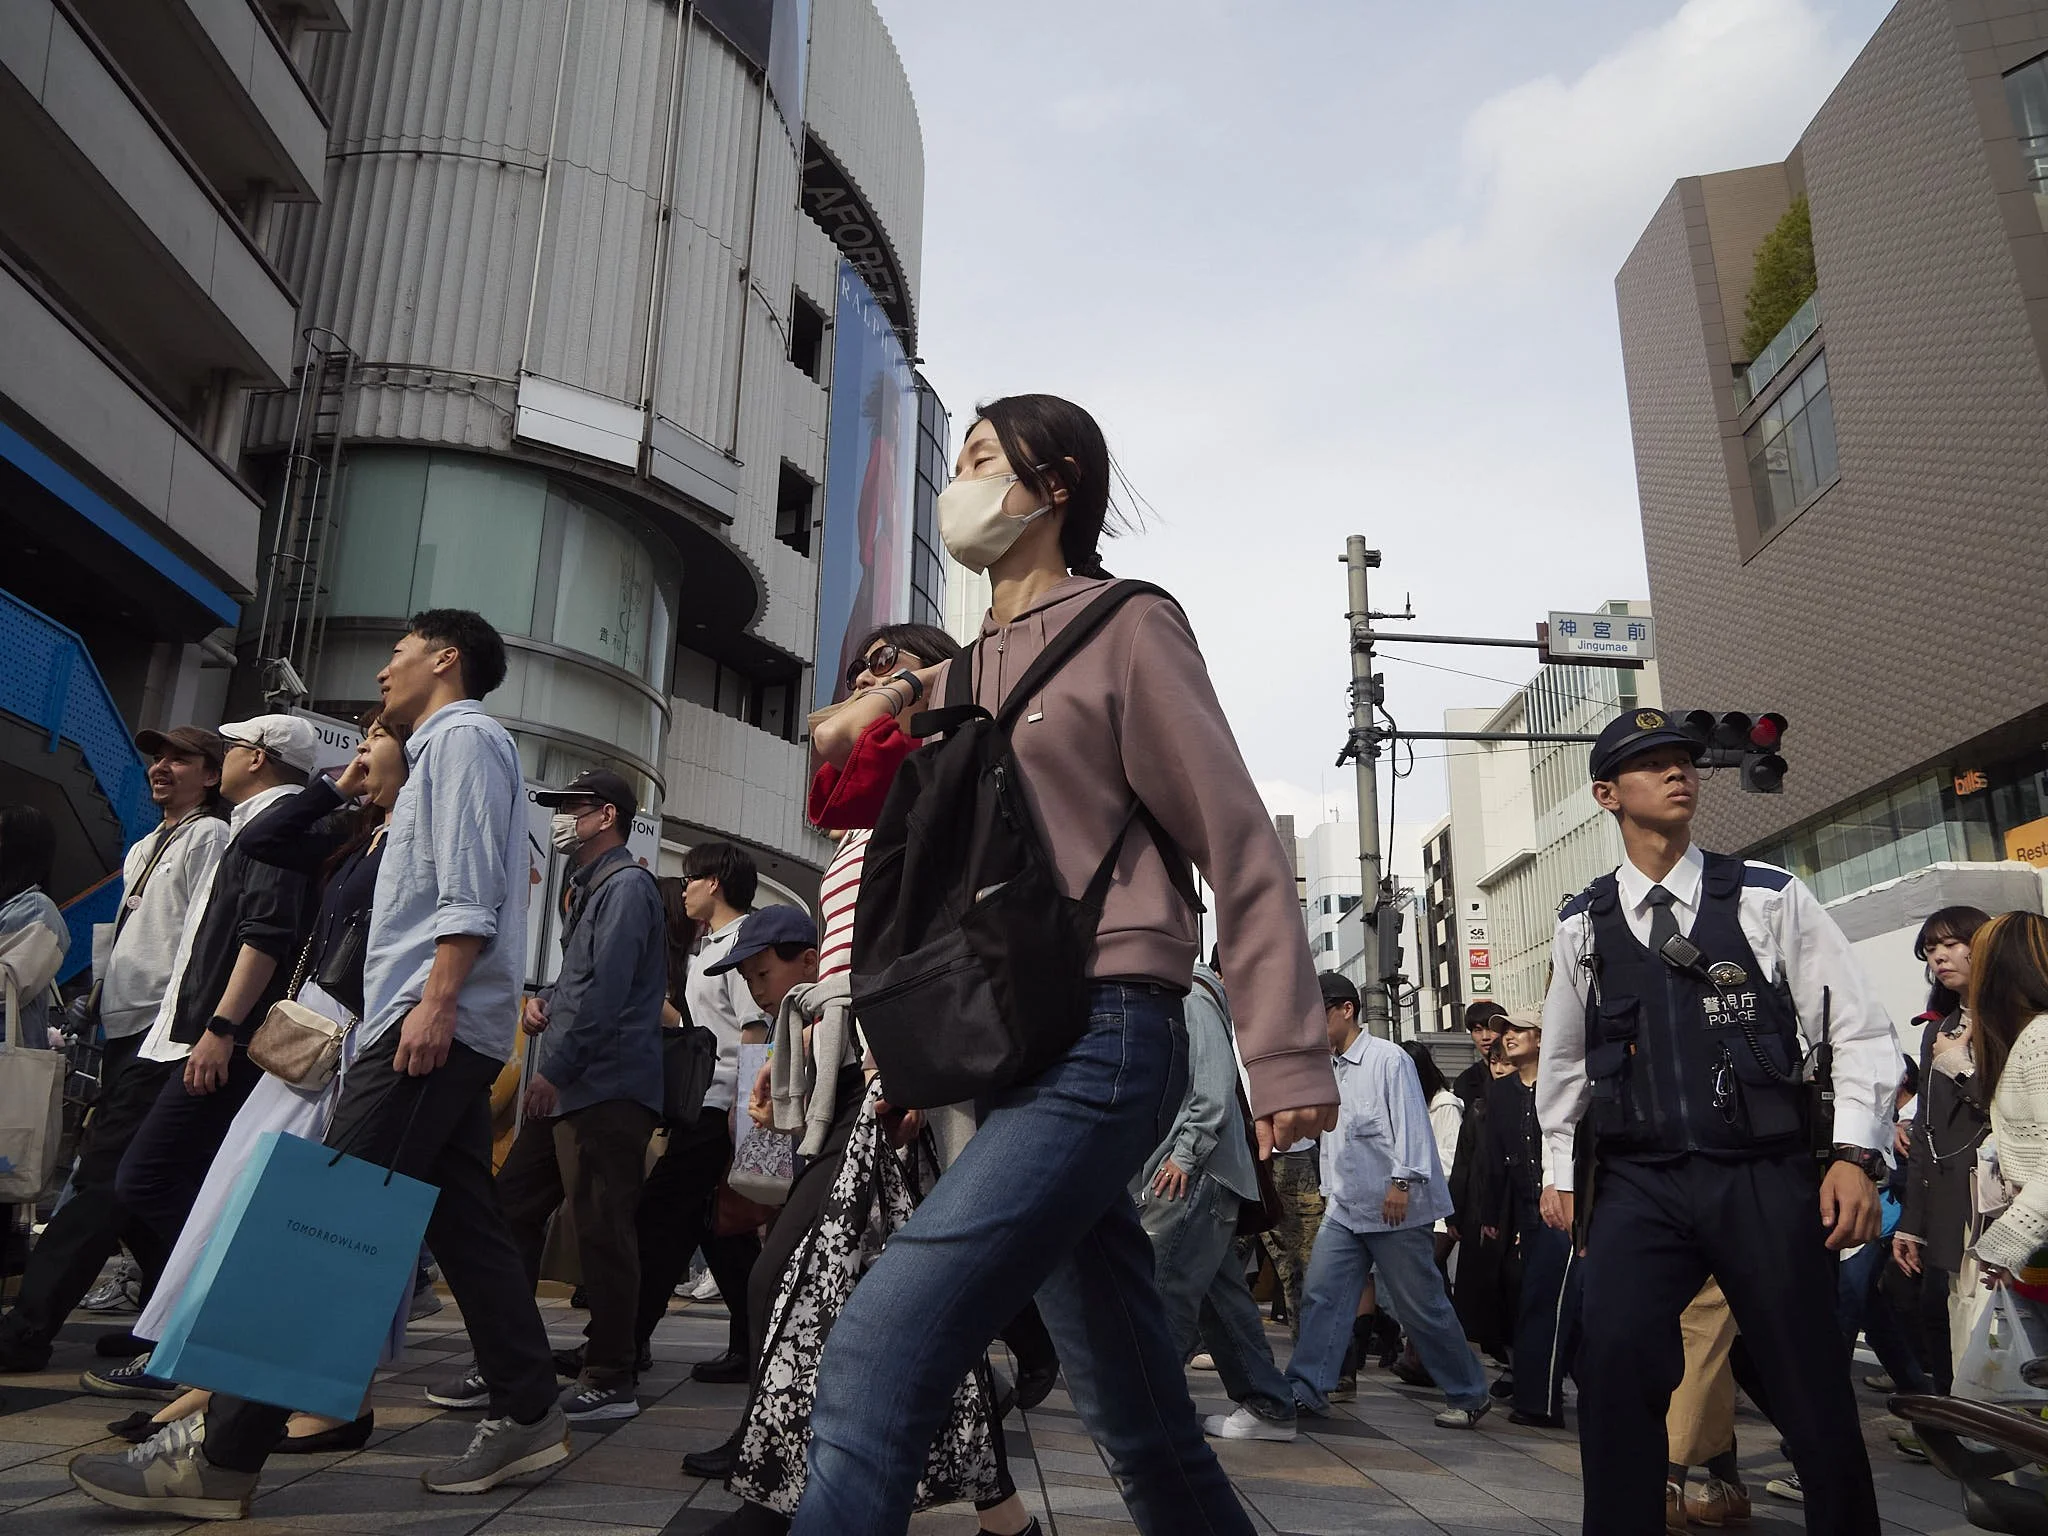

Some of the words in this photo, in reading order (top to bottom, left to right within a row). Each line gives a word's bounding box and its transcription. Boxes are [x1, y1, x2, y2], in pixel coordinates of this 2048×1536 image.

[841, 276, 888, 353] RALPH
[1558, 618, 1646, 641] 神宮前
[1577, 639, 1629, 653] Jingumae
[314, 726, 350, 749] UIS
[1954, 768, 1988, 796] bills
[632, 819, 655, 837] TON
[2016, 841, 2048, 861] Rest
[1702, 991, 1757, 1013] 警視庁
[1708, 1008, 1757, 1024] POLCE
[286, 1219, 378, 1255] TOMORROWLAND
